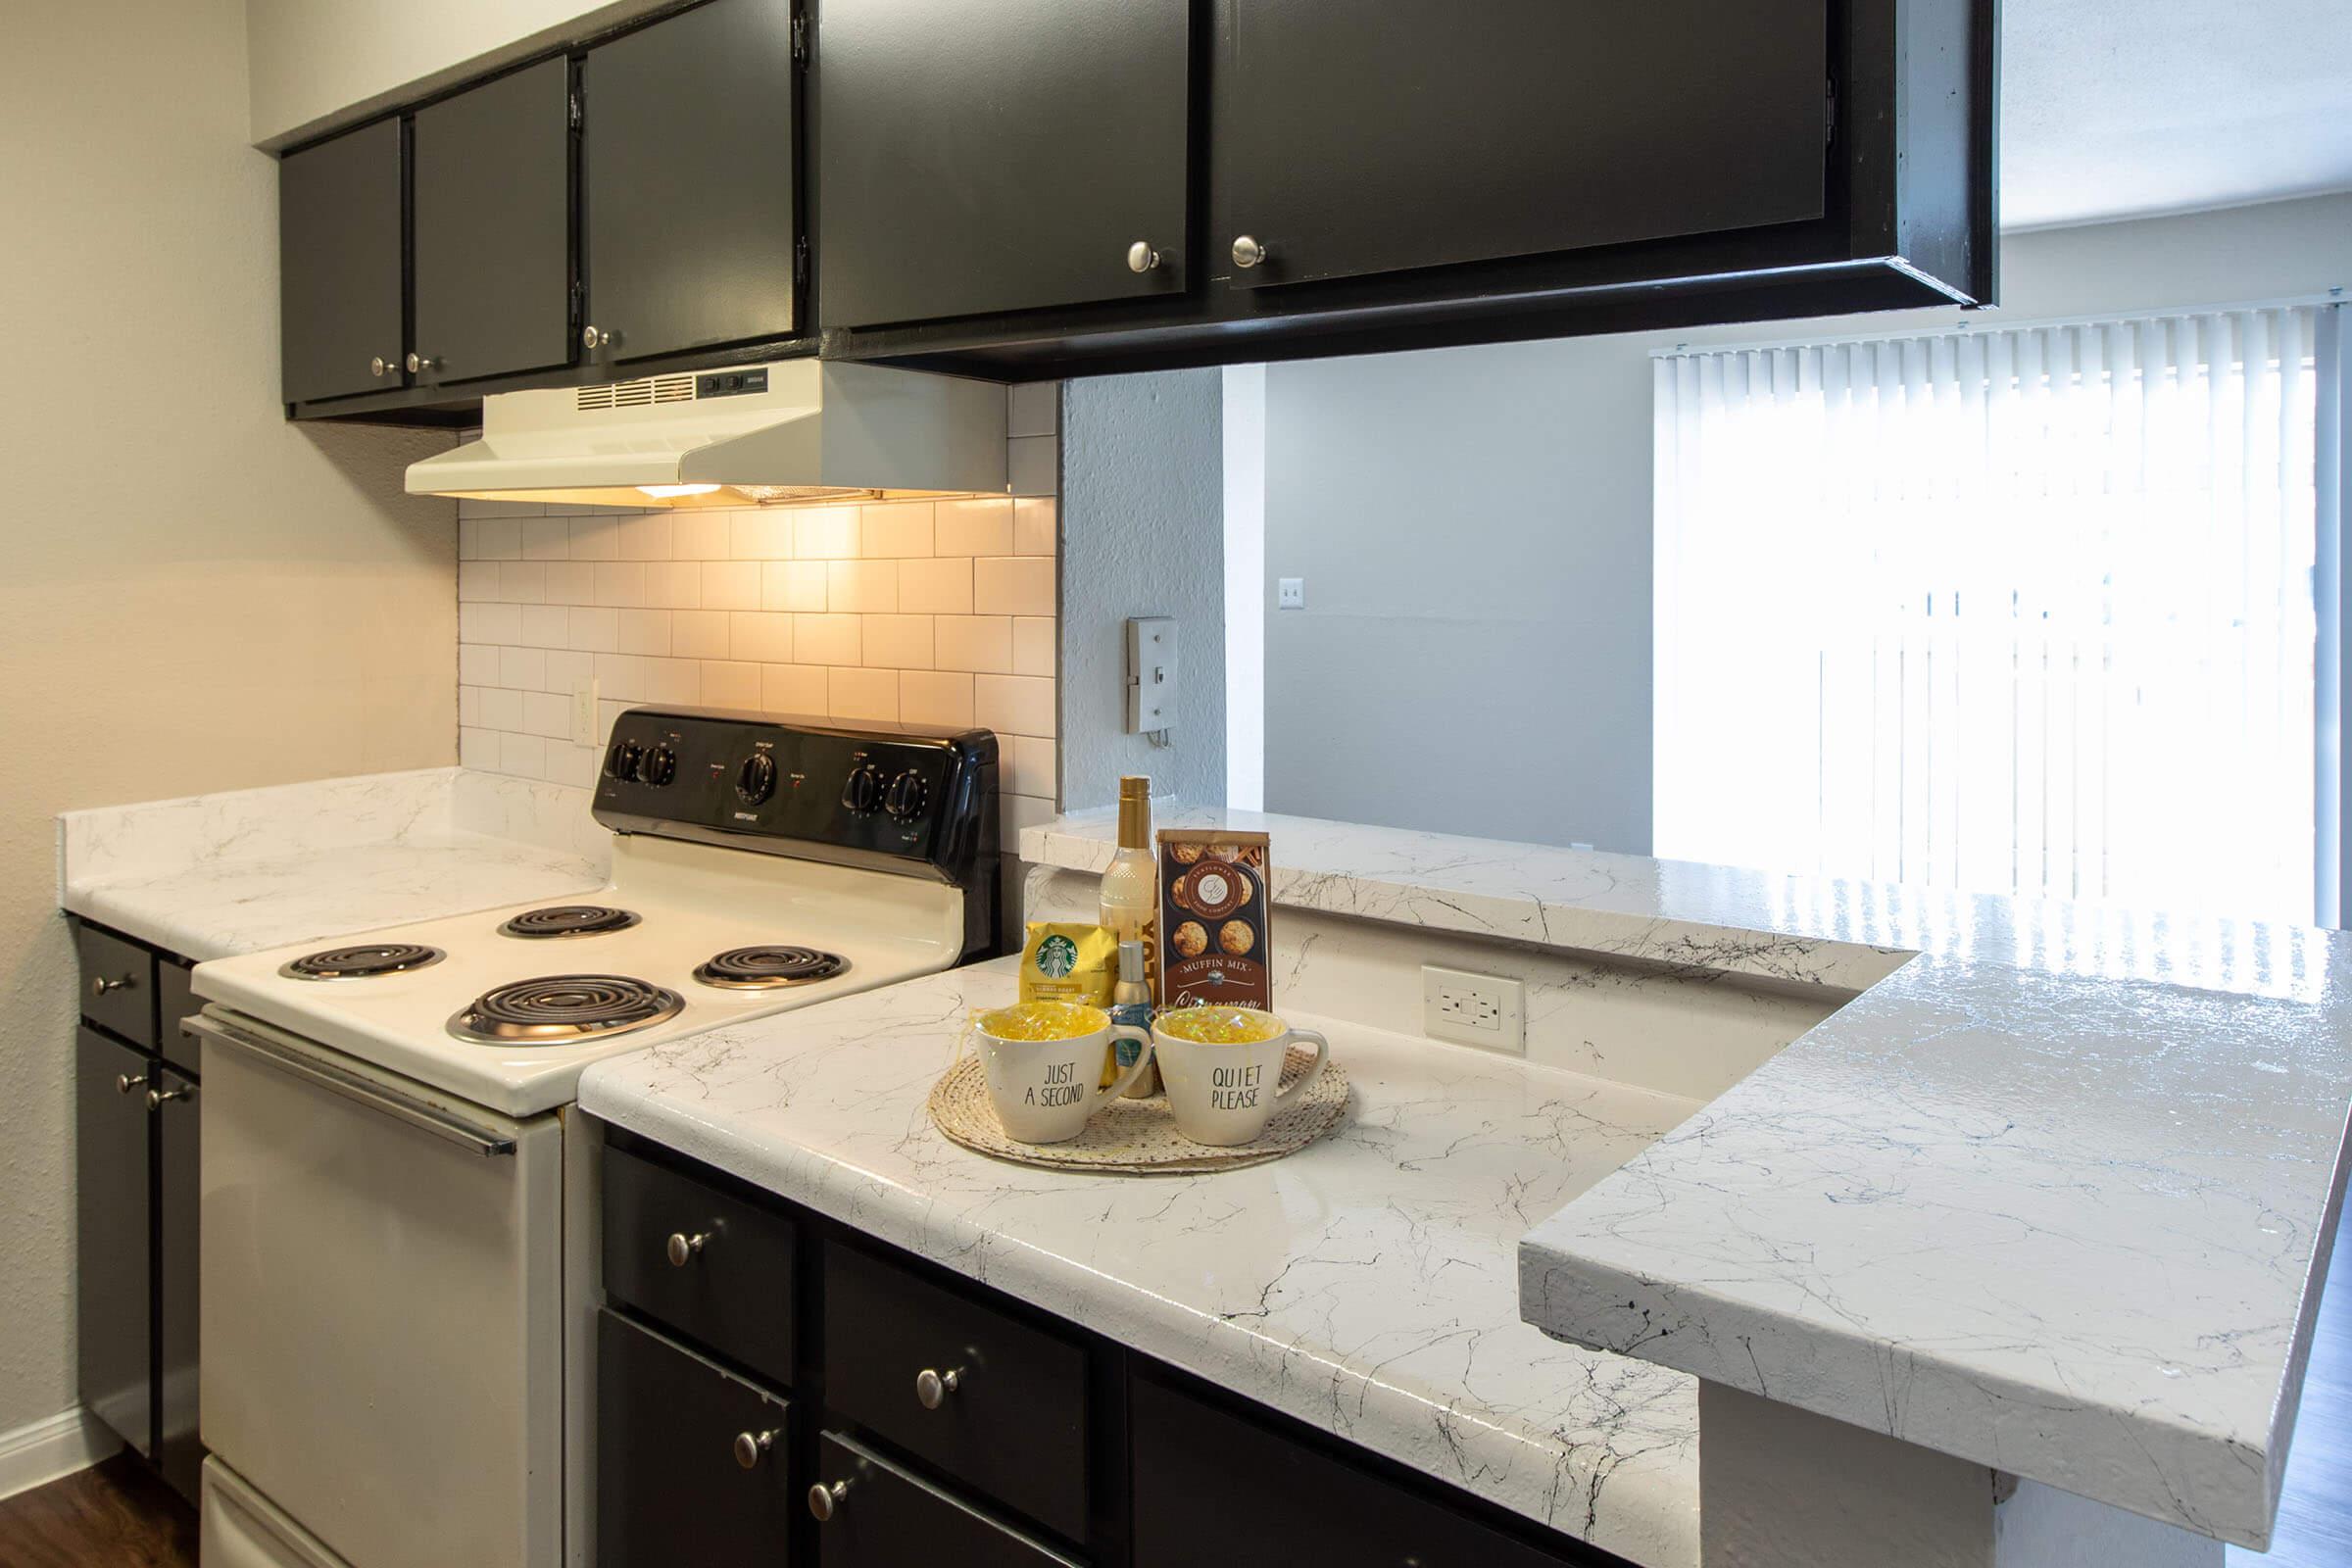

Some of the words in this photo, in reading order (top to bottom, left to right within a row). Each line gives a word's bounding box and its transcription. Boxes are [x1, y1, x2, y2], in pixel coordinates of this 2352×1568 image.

[1183, 958, 1224, 974] MUFFIN
[1227, 960, 1248, 972] MIX
[1044, 1061, 1076, 1085] JUST
[1212, 1064, 1262, 1089] QUIET
[1024, 1086, 1035, 1106] A
[1041, 1083, 1084, 1107] SECOND
[1211, 1089, 1259, 1110] PLEASE
